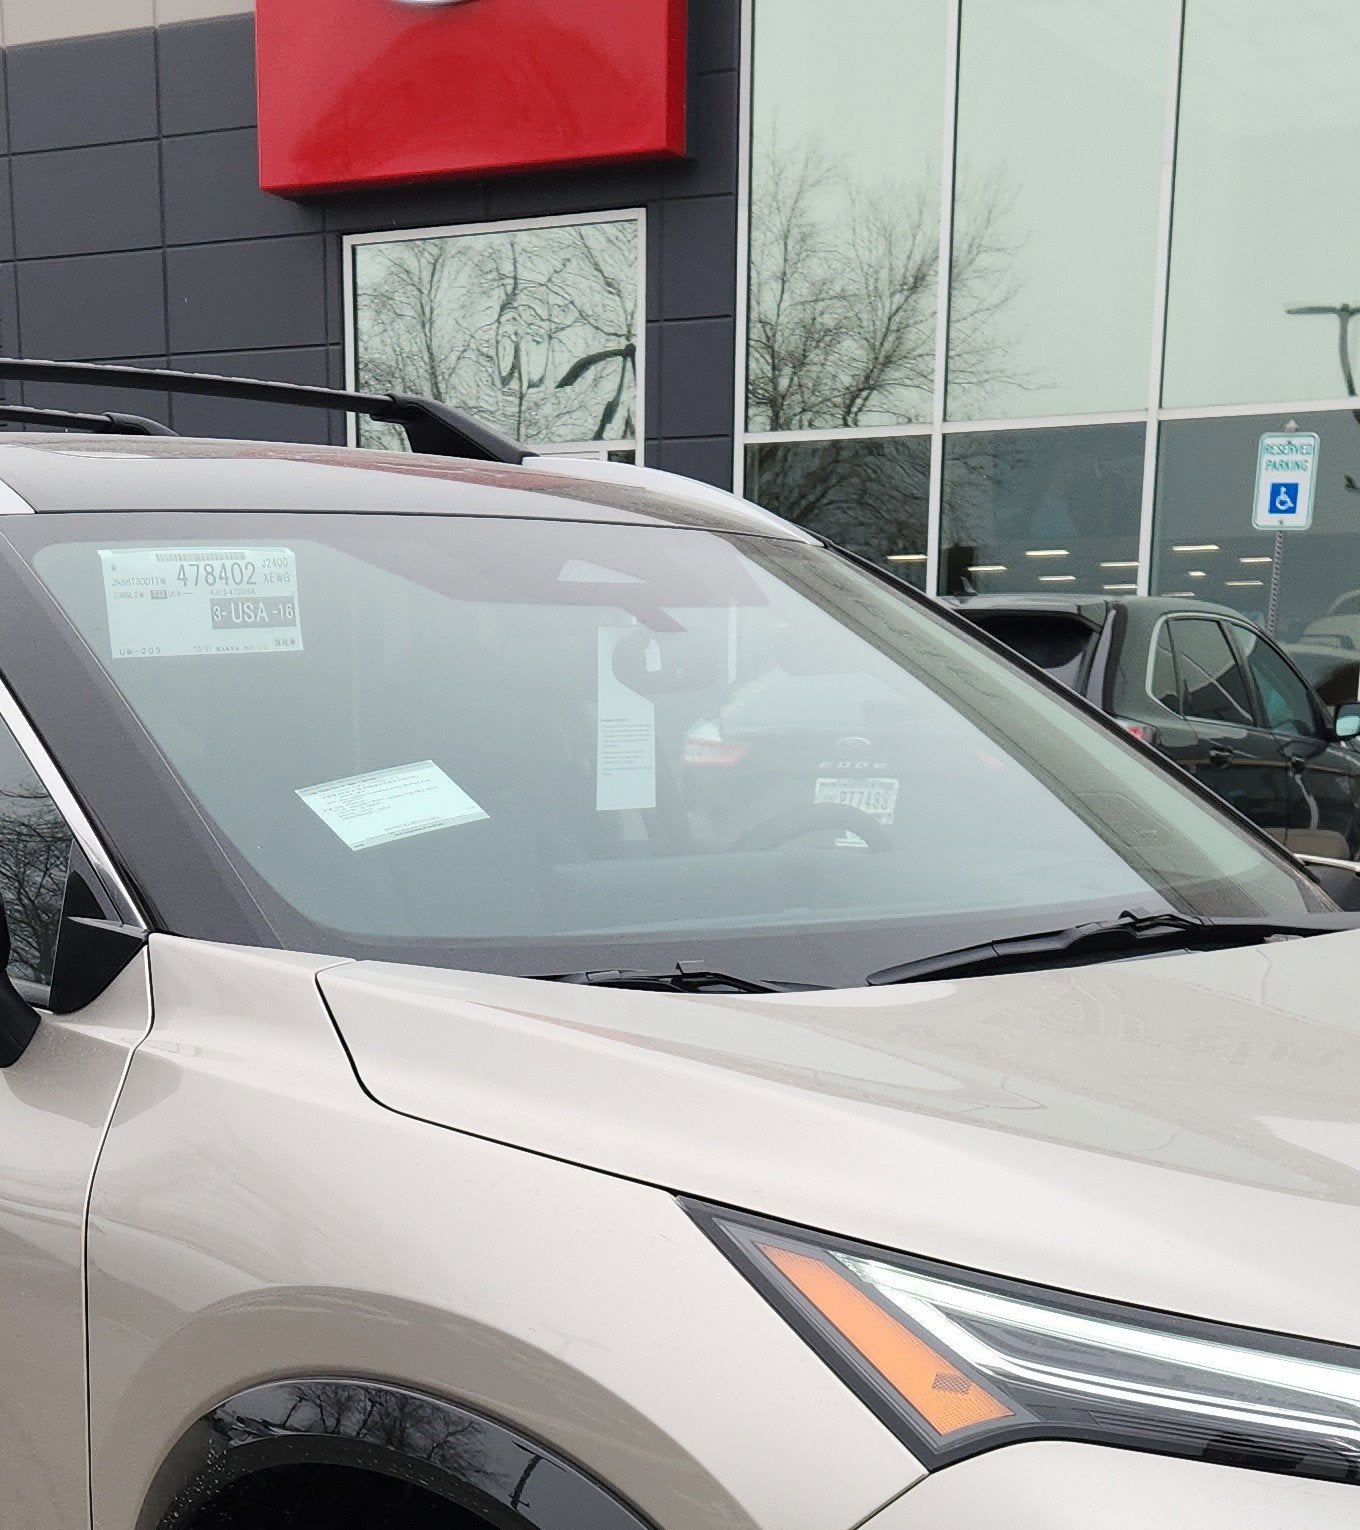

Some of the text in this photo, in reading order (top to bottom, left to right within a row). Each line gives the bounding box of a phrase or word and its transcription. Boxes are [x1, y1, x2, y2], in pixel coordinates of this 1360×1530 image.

[1265, 459, 1309, 471] PARKING
[176, 561, 258, 587] 478402
[230, 601, 269, 623] USA
